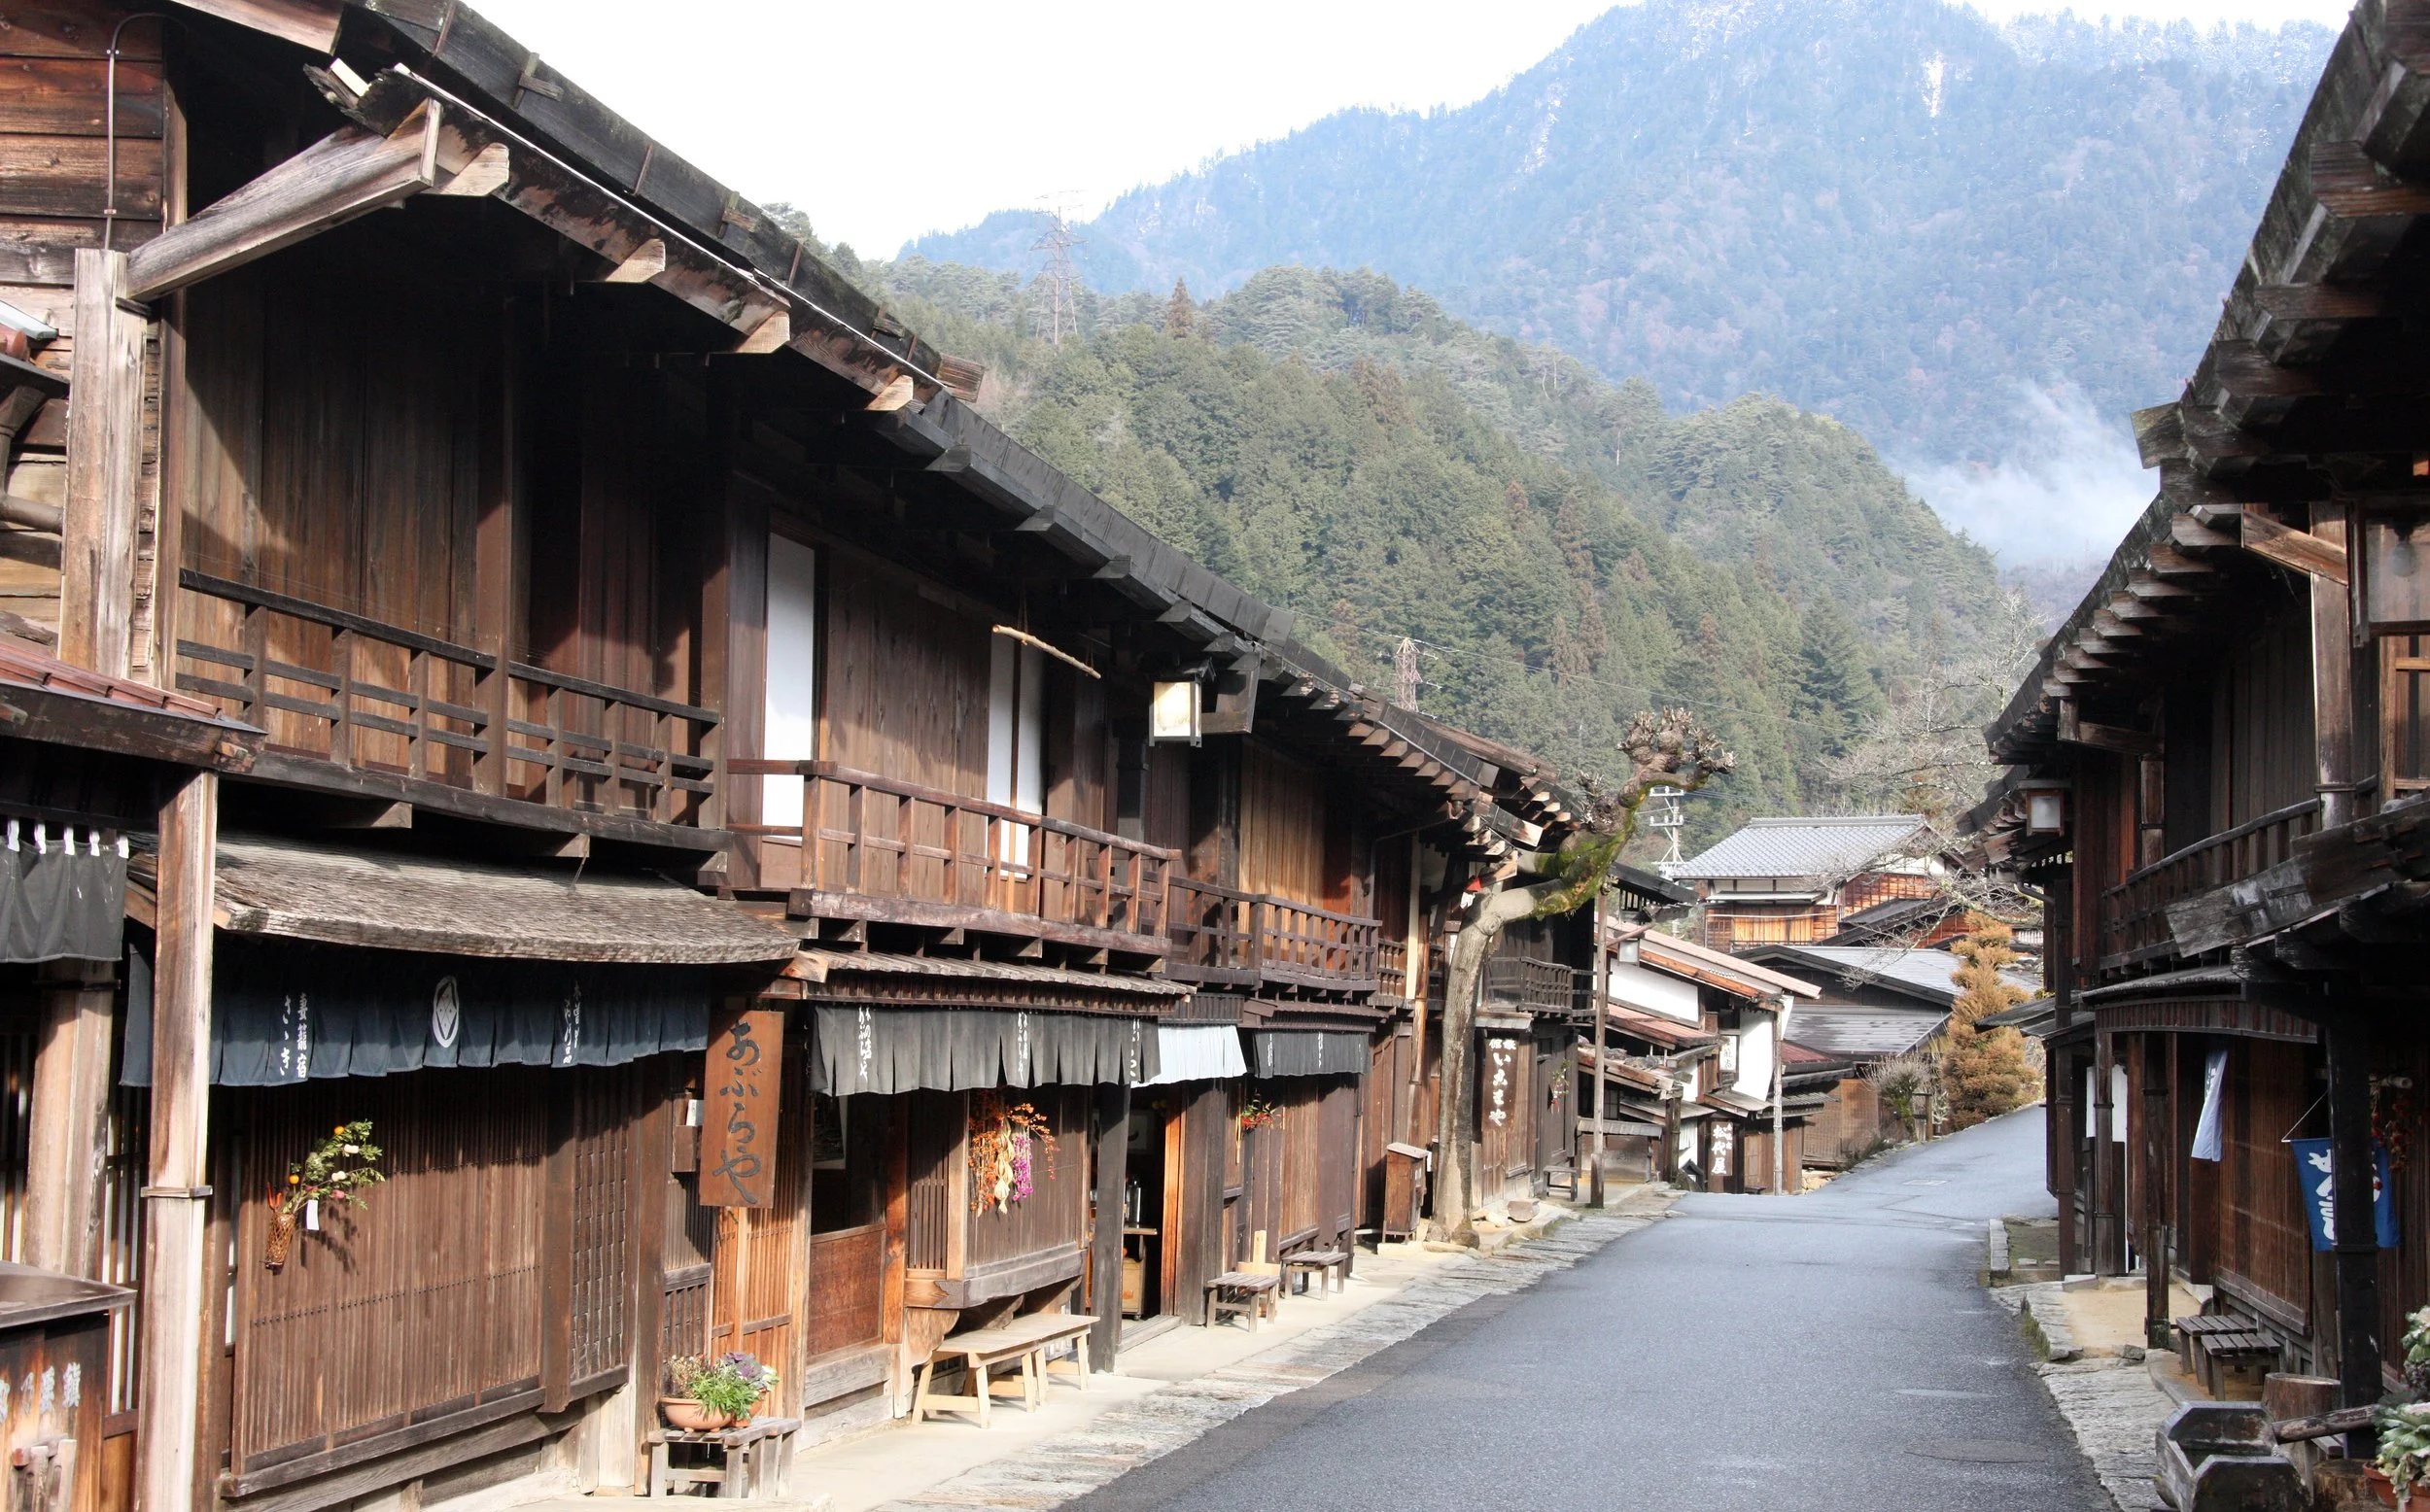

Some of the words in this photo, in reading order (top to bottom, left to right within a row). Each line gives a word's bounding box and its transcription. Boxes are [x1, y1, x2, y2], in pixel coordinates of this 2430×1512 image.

[295, 991, 309, 1079] 妻籠宿
[712, 1020, 763, 1205] あぶらや
[1711, 1123, 1727, 1175] 松代屋
